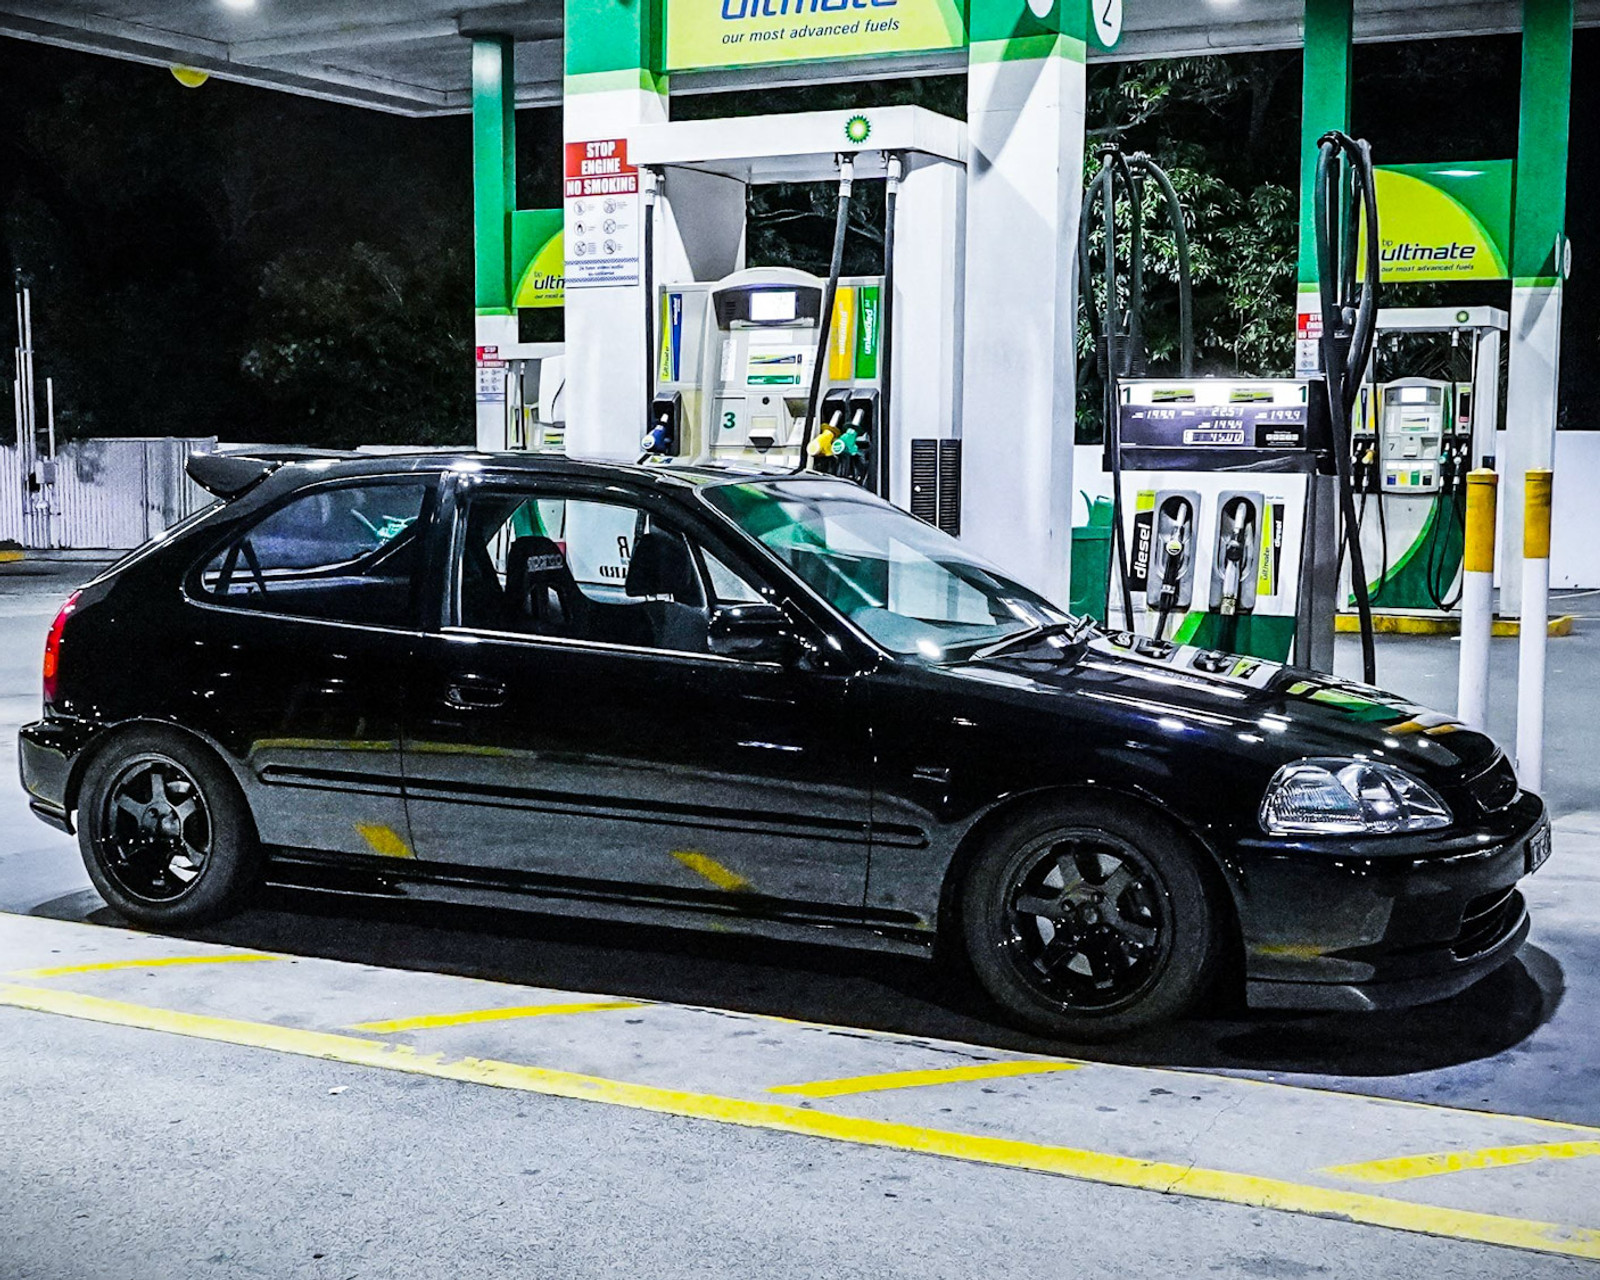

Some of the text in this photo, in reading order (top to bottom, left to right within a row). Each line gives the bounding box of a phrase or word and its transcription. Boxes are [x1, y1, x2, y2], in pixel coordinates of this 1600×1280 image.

[722, 18, 900, 45] our most advanced fuels
[586, 141, 616, 158] STOP
[581, 158, 621, 175] ENGINE
[566, 176, 637, 196] NO SMOKING
[1381, 242, 1476, 261] ultimate
[1298, 385, 1307, 403] 1
[723, 411, 736, 429] 3
[1133, 522, 1151, 579] diesel
